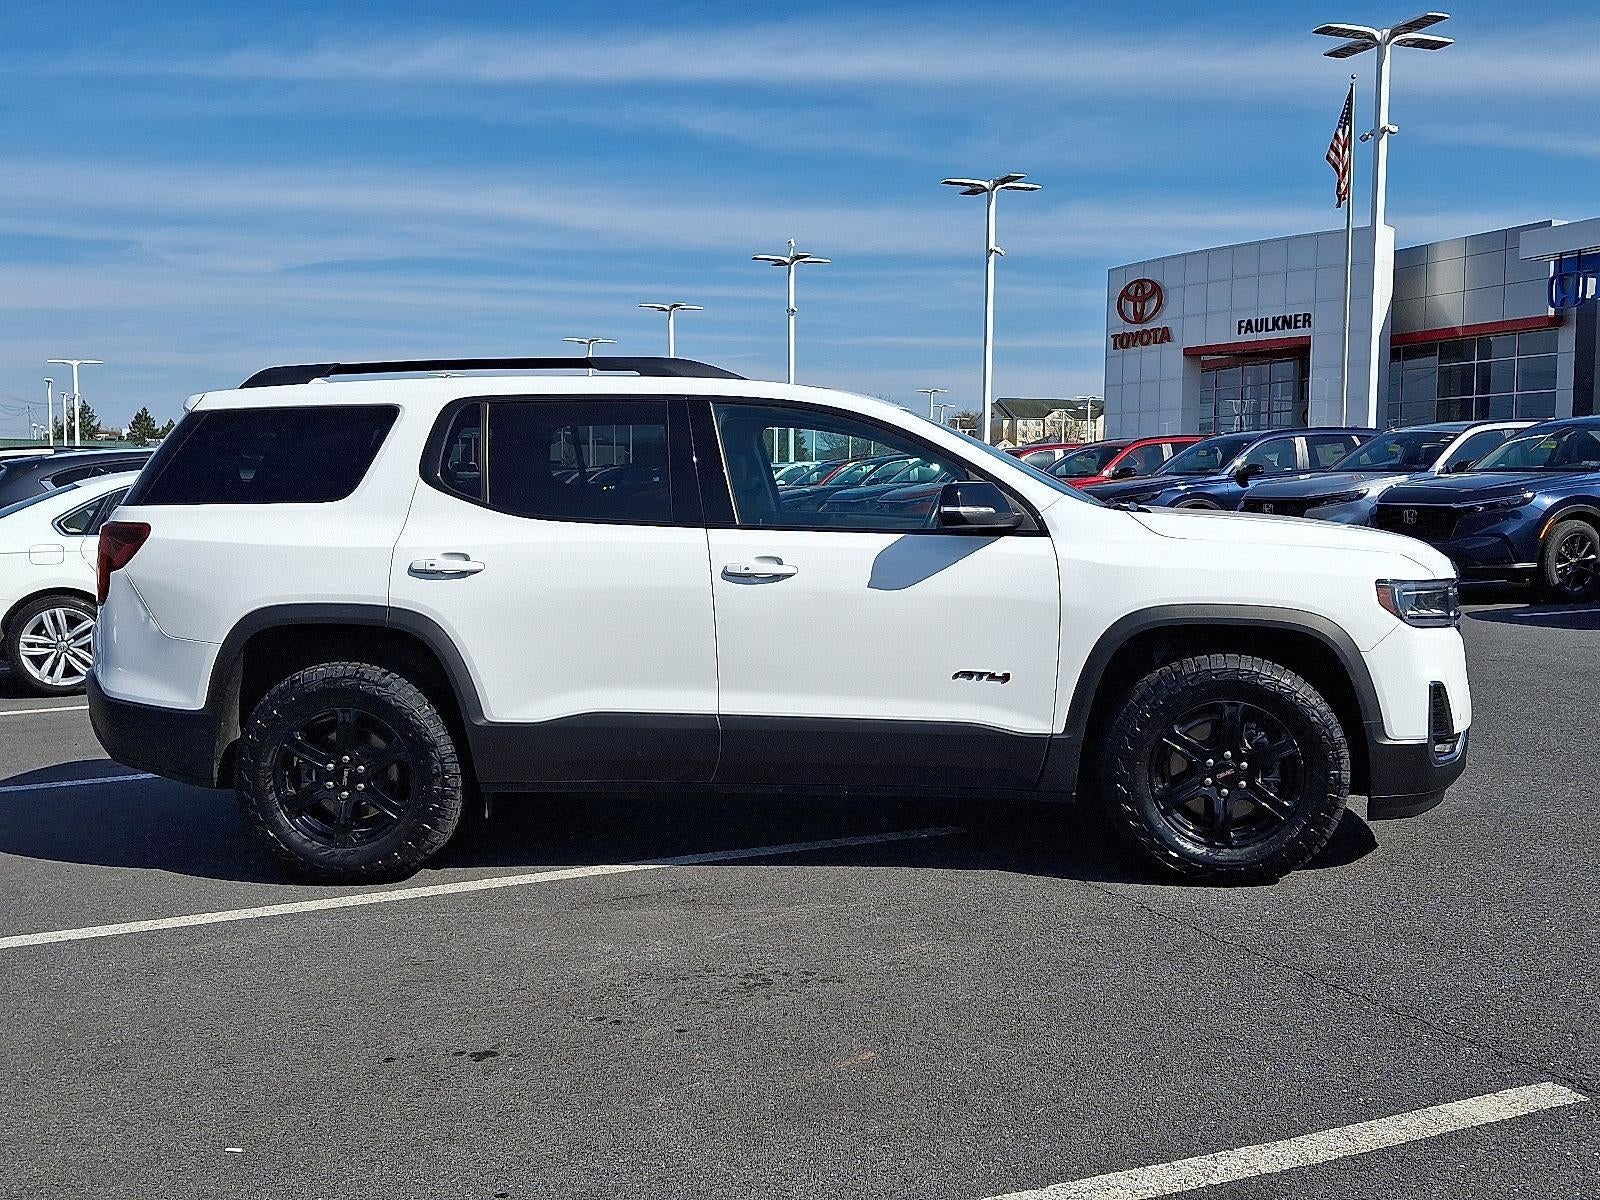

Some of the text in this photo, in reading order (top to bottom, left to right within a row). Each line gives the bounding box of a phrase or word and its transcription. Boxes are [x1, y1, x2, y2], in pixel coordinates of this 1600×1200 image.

[1237, 312, 1312, 335] FAULKNER
[1111, 326, 1173, 350] TOYOTA
[951, 670, 1011, 684] AT4
[1216, 768, 1235, 779] GMC
